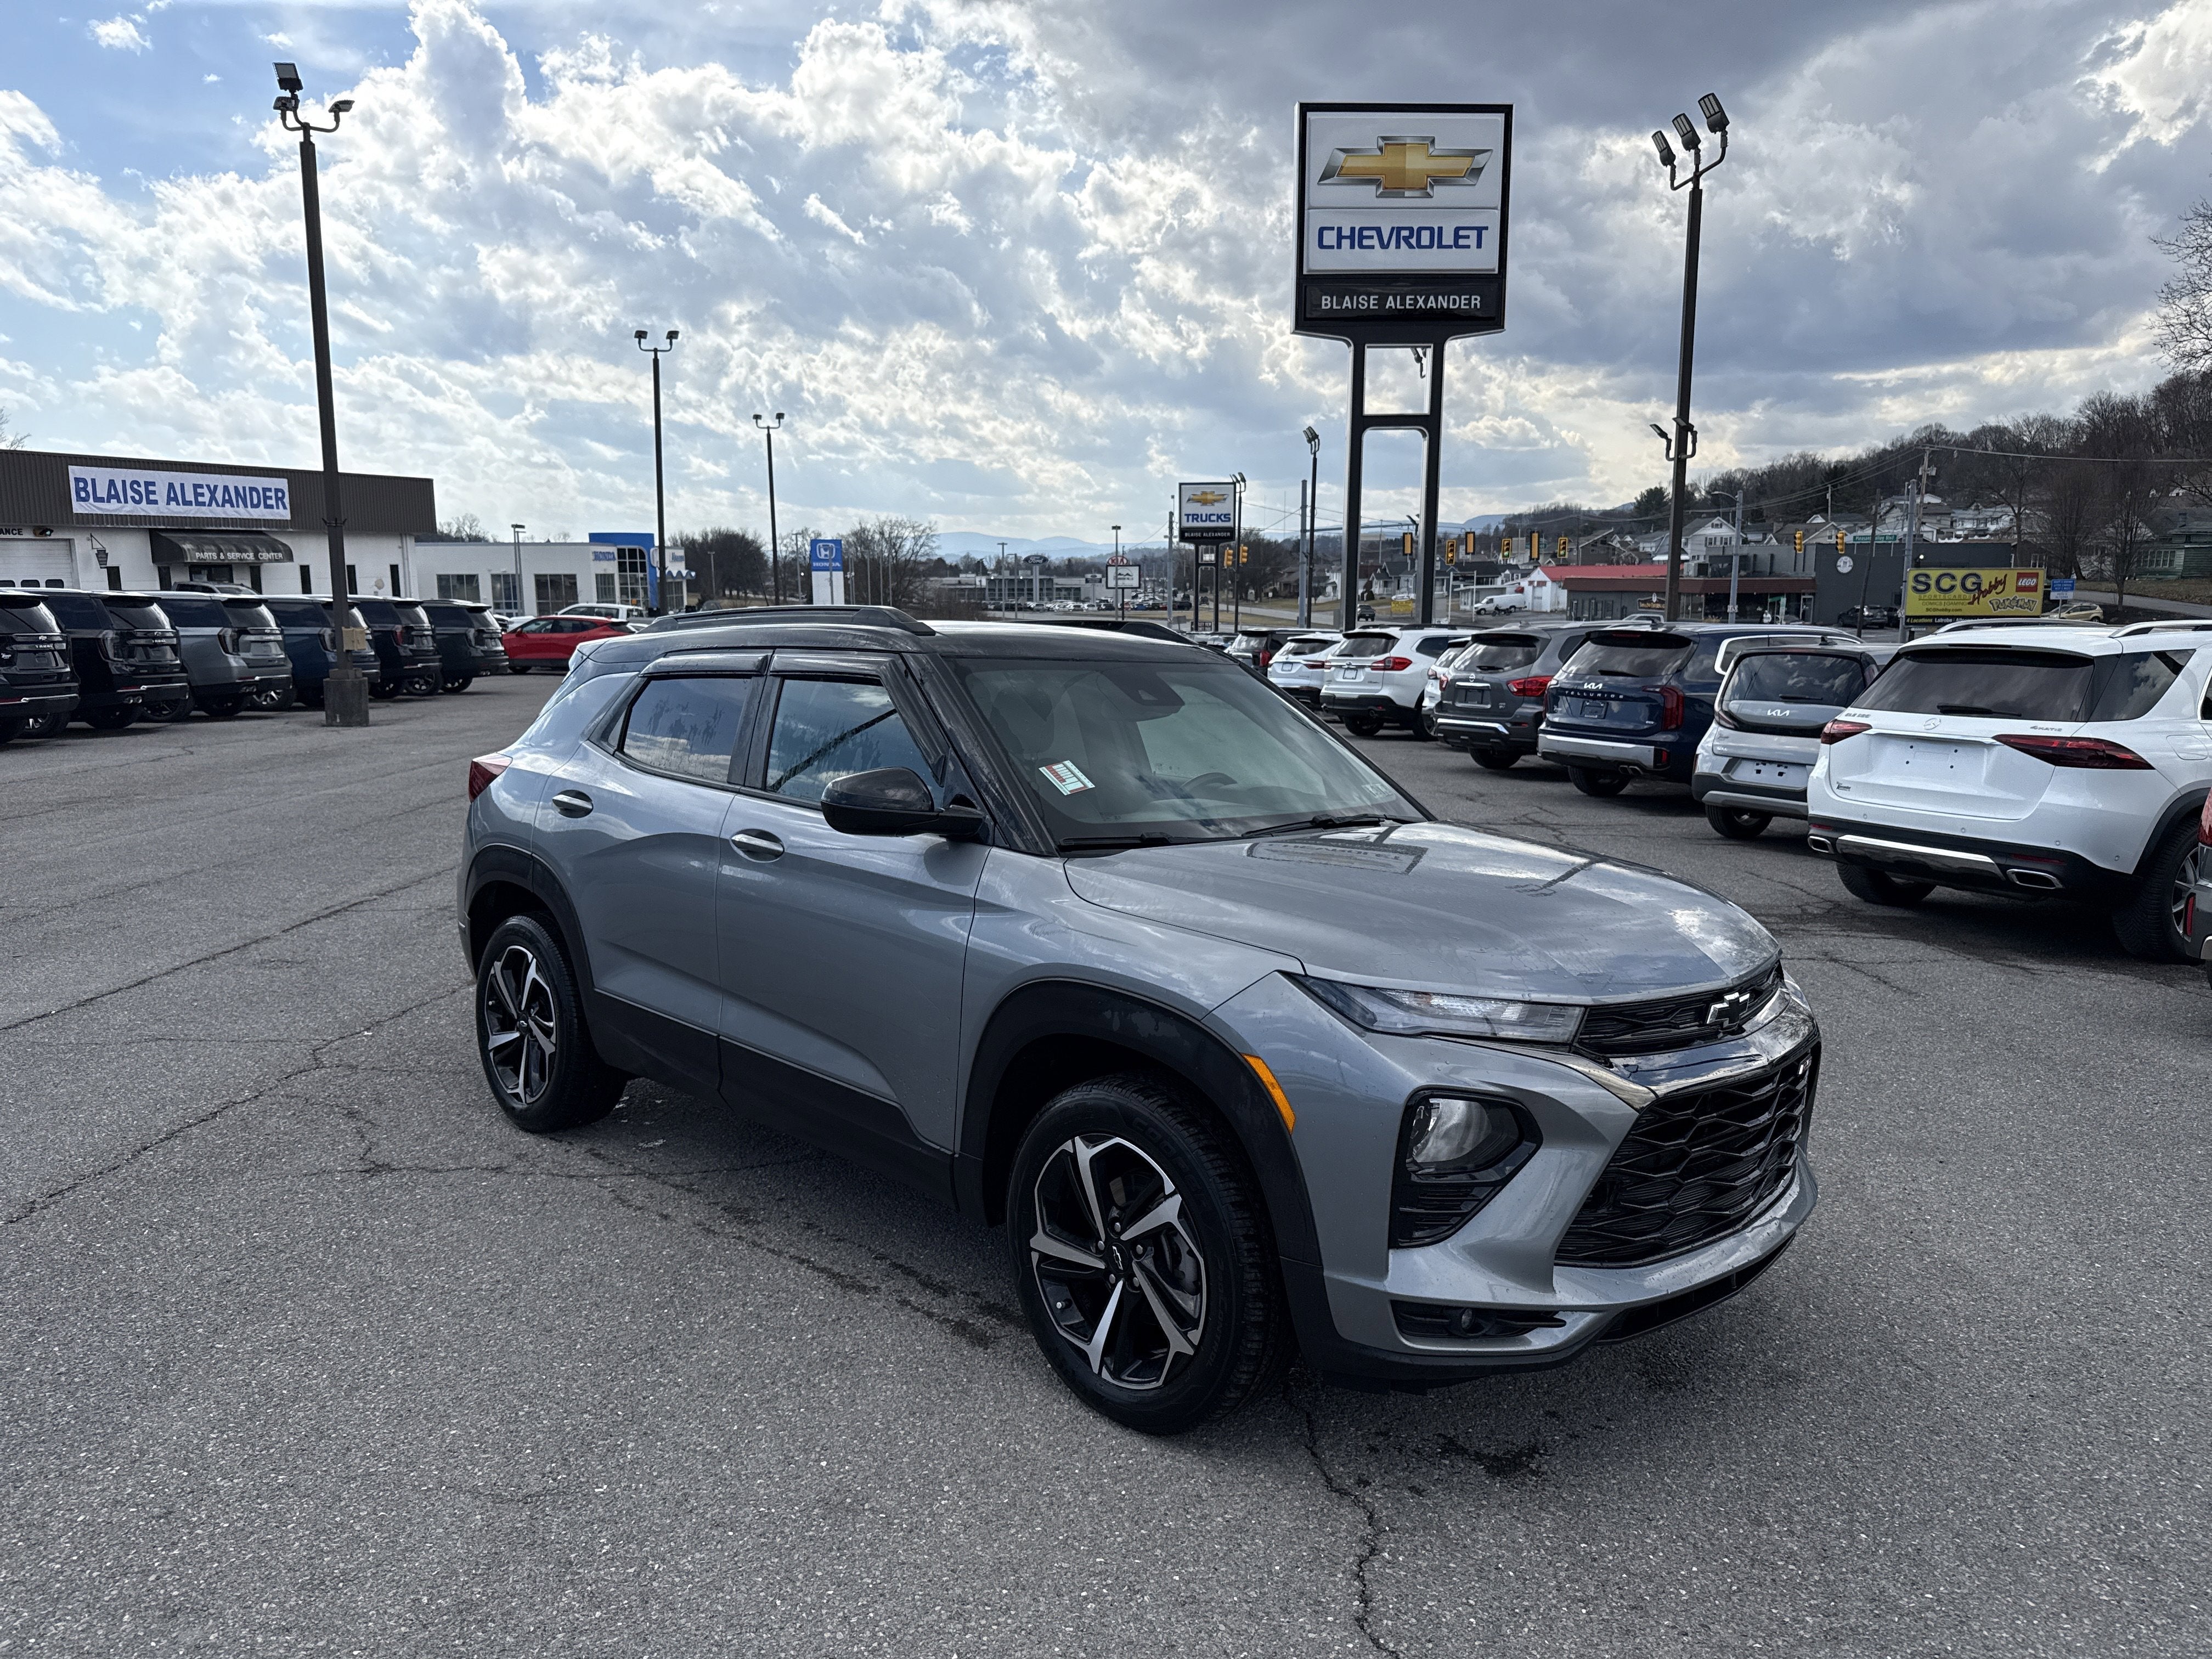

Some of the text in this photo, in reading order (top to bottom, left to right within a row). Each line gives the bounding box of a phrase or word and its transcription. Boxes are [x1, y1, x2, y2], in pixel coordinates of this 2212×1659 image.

[1318, 226, 1488, 250] CHEVROLET
[1321, 295, 1481, 309] BLAISE ALEXANDER
[74, 477, 288, 510] BLAISE ALEXANDER
[1184, 513, 1231, 523] TRUCKS
[195, 552, 217, 560] PARTS
[227, 552, 255, 560] SERVICE
[592, 551, 616, 561] HONDA
[1911, 572, 1983, 595] SCG
[2018, 578, 2037, 586] LEGO
[1565, 690, 1624, 699] TELLURIDE
[1767, 708, 1790, 717] KIA
